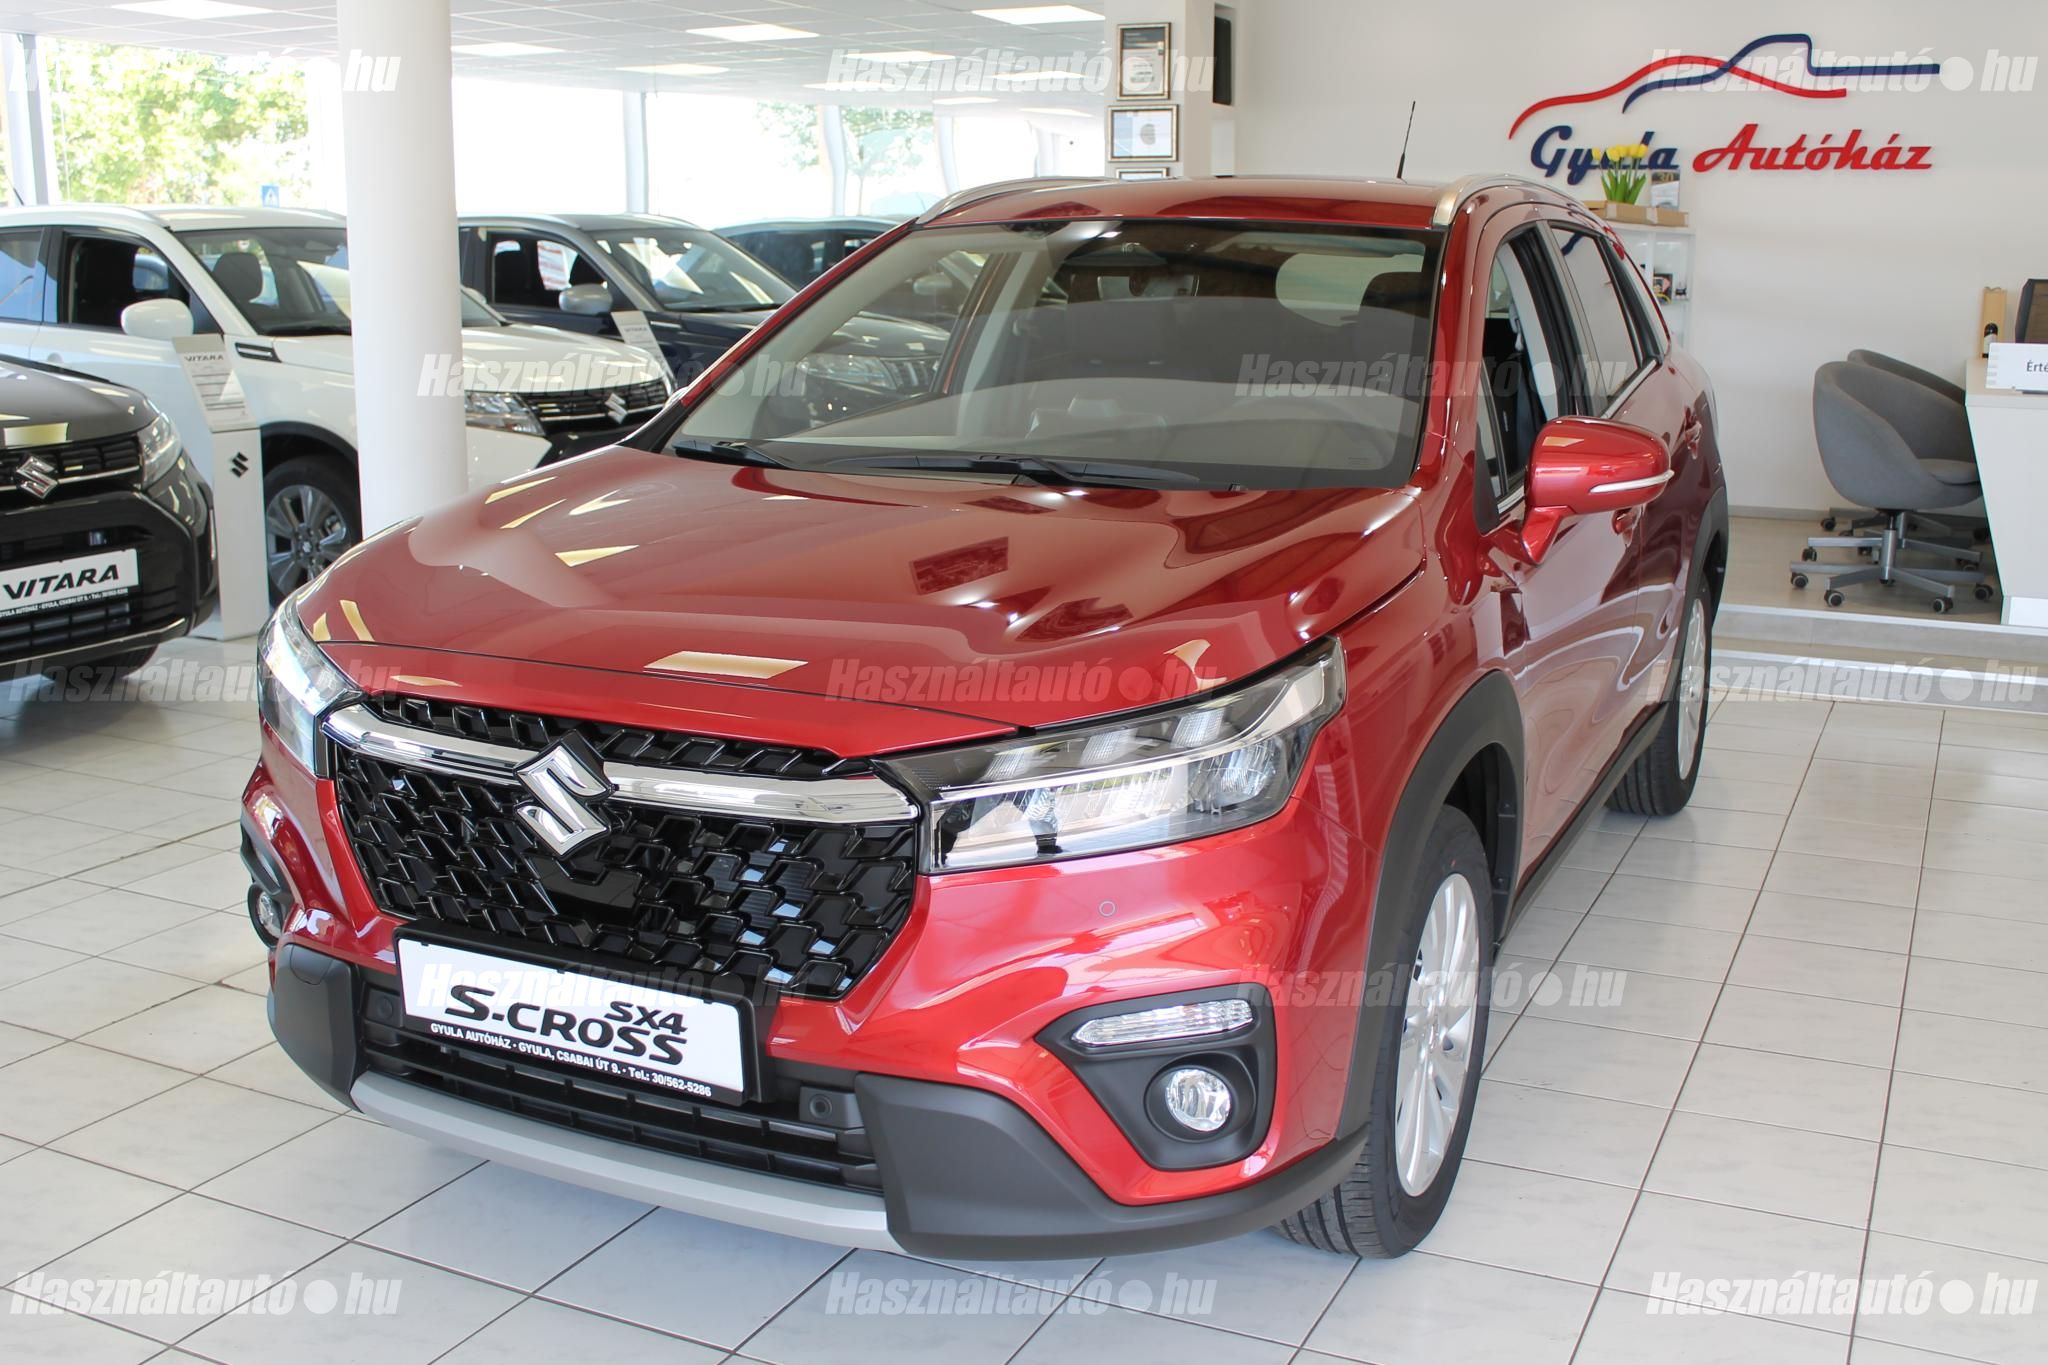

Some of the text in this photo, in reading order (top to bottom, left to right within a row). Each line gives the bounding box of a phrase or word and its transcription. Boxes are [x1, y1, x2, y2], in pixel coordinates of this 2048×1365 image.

[1692, 123, 1933, 173] Autóház
[3, 564, 119, 600] VITARA
[604, 1000, 688, 1035] SX4
[430, 1022, 464, 1039] GYULA
[465, 1030, 511, 1049] AUTÓHÁZ
[518, 1042, 555, 1061] GYULA,
[556, 1050, 594, 1068] CSABAI
[595, 1057, 609, 1071] ÚT
[611, 1062, 621, 1074] 9.
